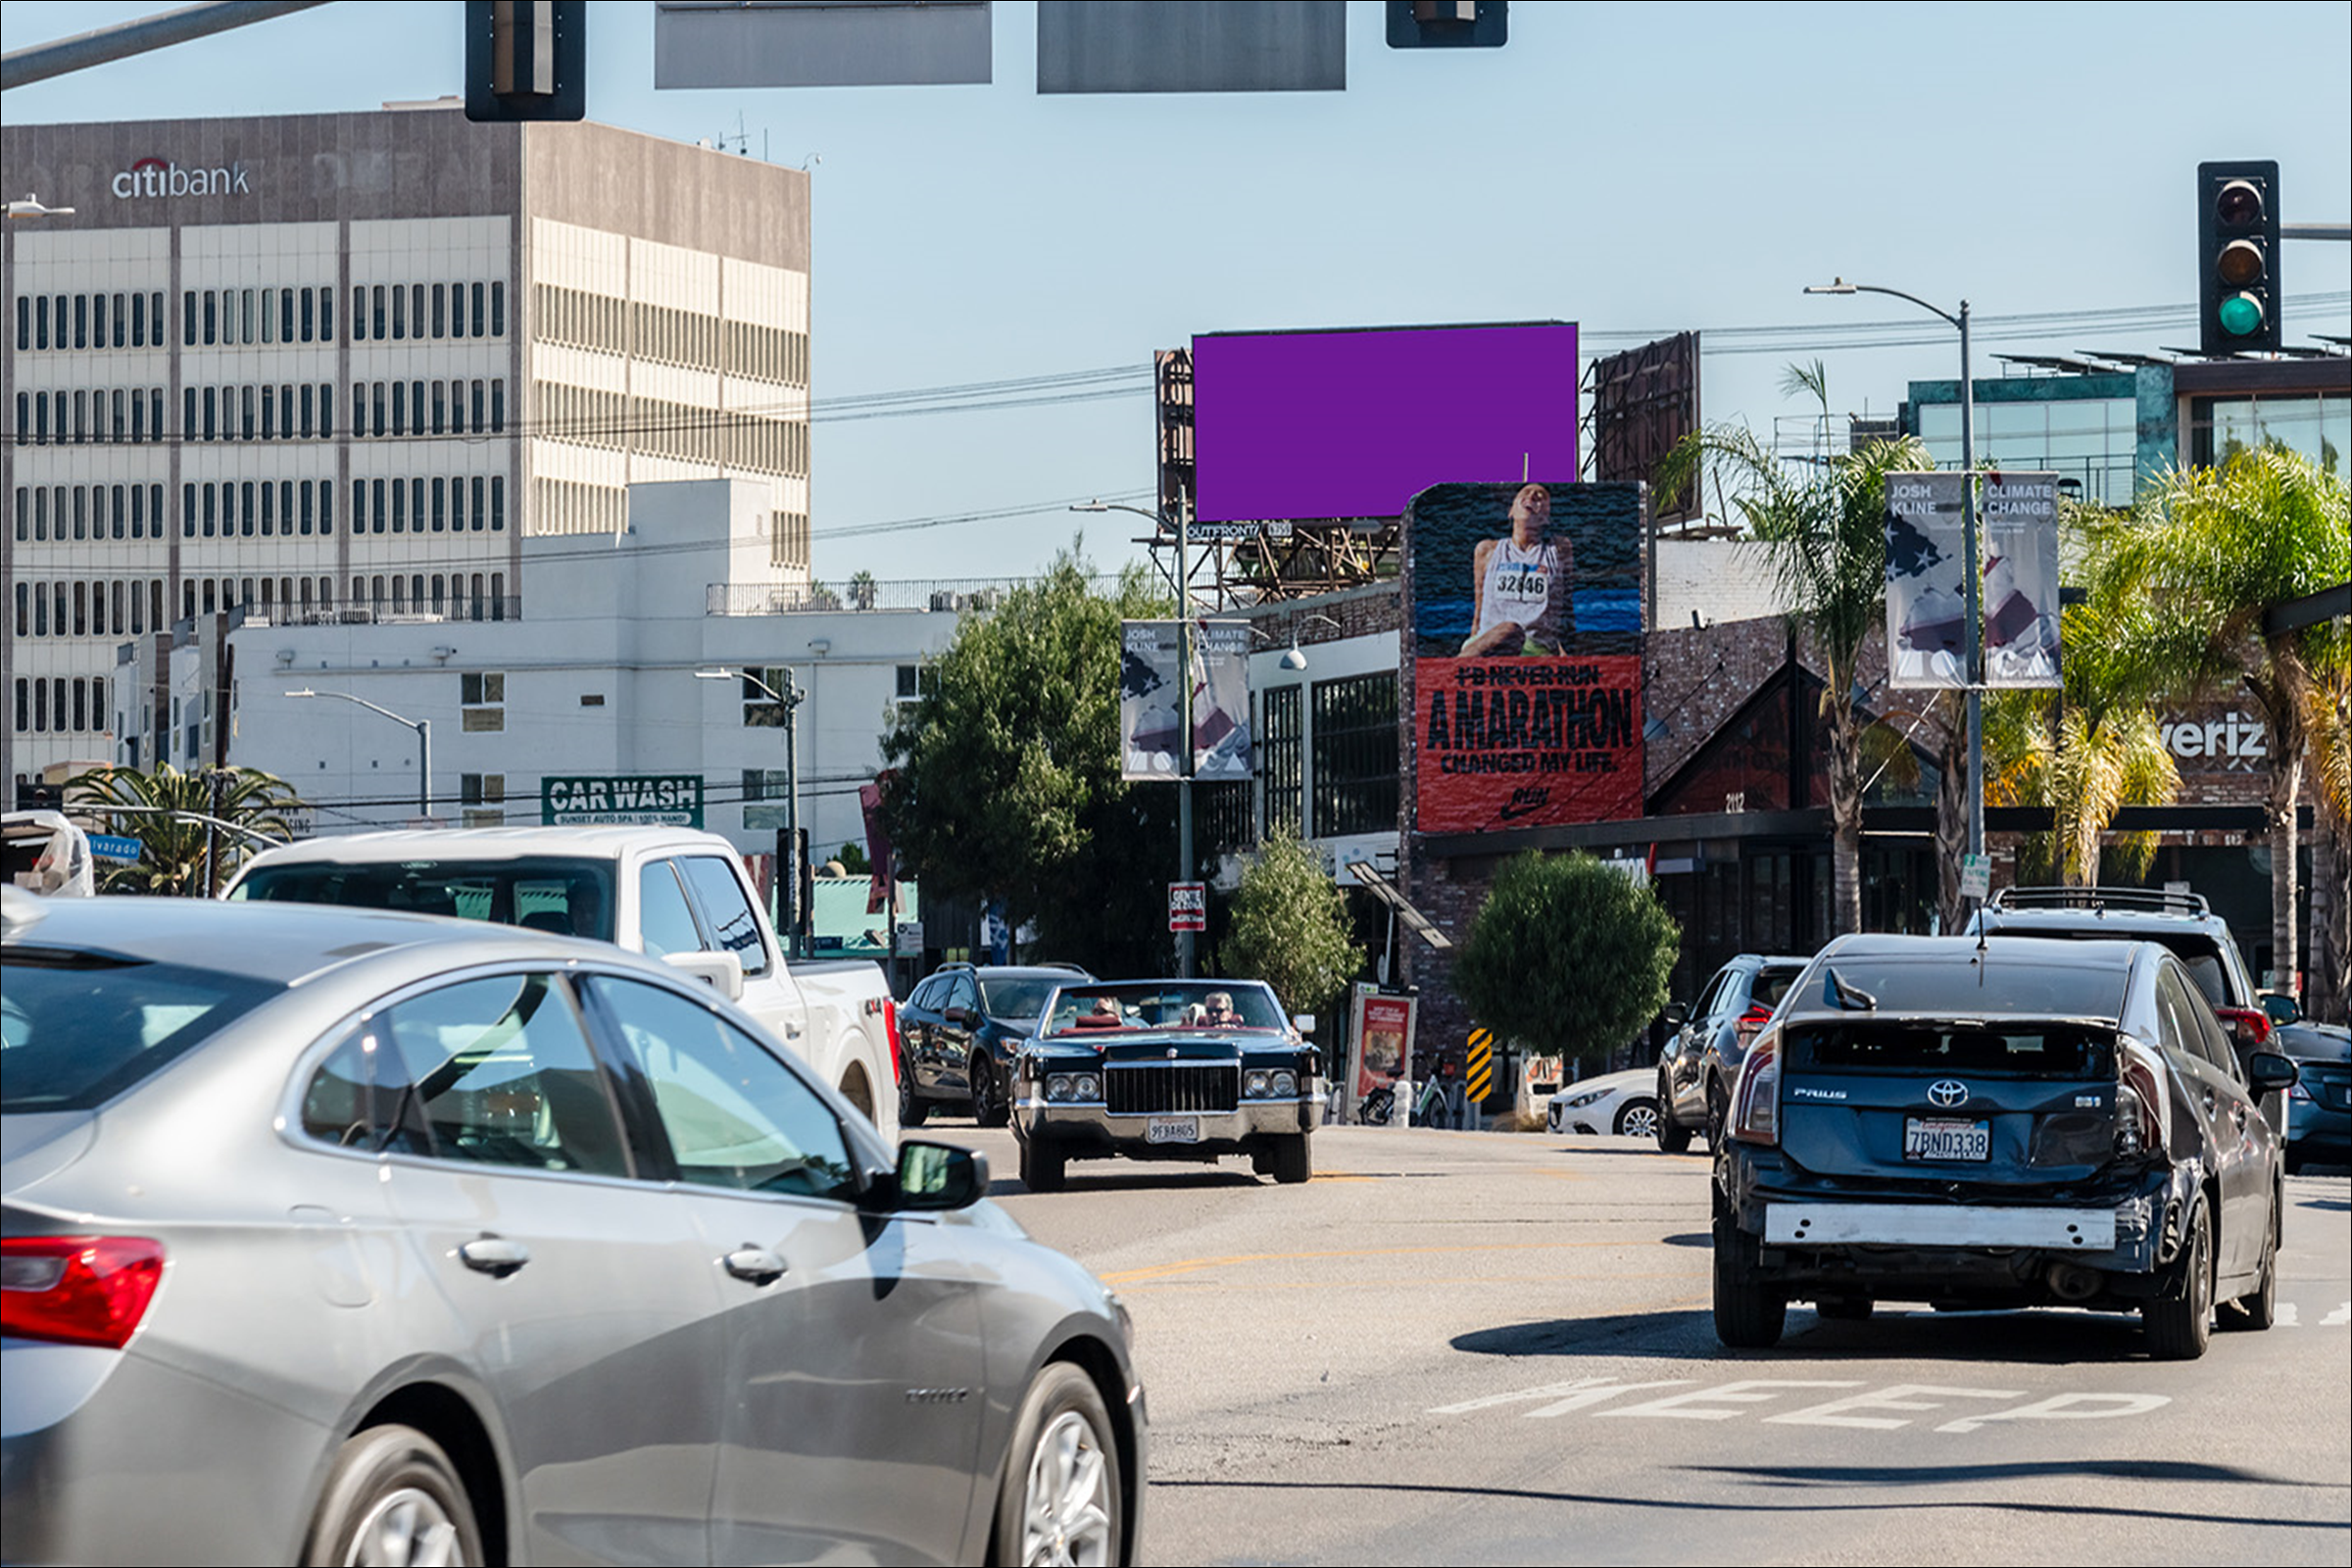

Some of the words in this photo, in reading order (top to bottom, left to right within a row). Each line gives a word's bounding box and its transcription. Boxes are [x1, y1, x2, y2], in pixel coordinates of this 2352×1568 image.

[112, 160, 249, 198] citibank
[1891, 485, 1932, 499] JOSH
[1987, 484, 2052, 499] CLIMATE
[1891, 501, 1936, 516] KLINE
[1987, 501, 2051, 515] CHANGE
[1126, 629, 1156, 640] JOSH
[1126, 641, 1159, 653] KLINE
[1489, 665, 1554, 686] NEVER
[1557, 664, 1599, 685] RUN
[1427, 690, 1450, 750] A
[1453, 687, 1634, 750] MARATHON
[2160, 712, 2268, 758] veriz
[1441, 753, 1536, 774] CHANGED
[1540, 752, 1572, 773] MY
[550, 781, 609, 811] CAR
[612, 779, 696, 810] WASH
[1726, 792, 1744, 814] 2112
[561, 813, 591, 824] SUNSET
[593, 813, 616, 824] AUTO
[92, 840, 137, 855] lvarado
[1794, 1088, 1847, 1100] PRIUS
[1910, 1131, 1986, 1153] 7BND338
[1426, 1375, 2173, 1433] KEEP
